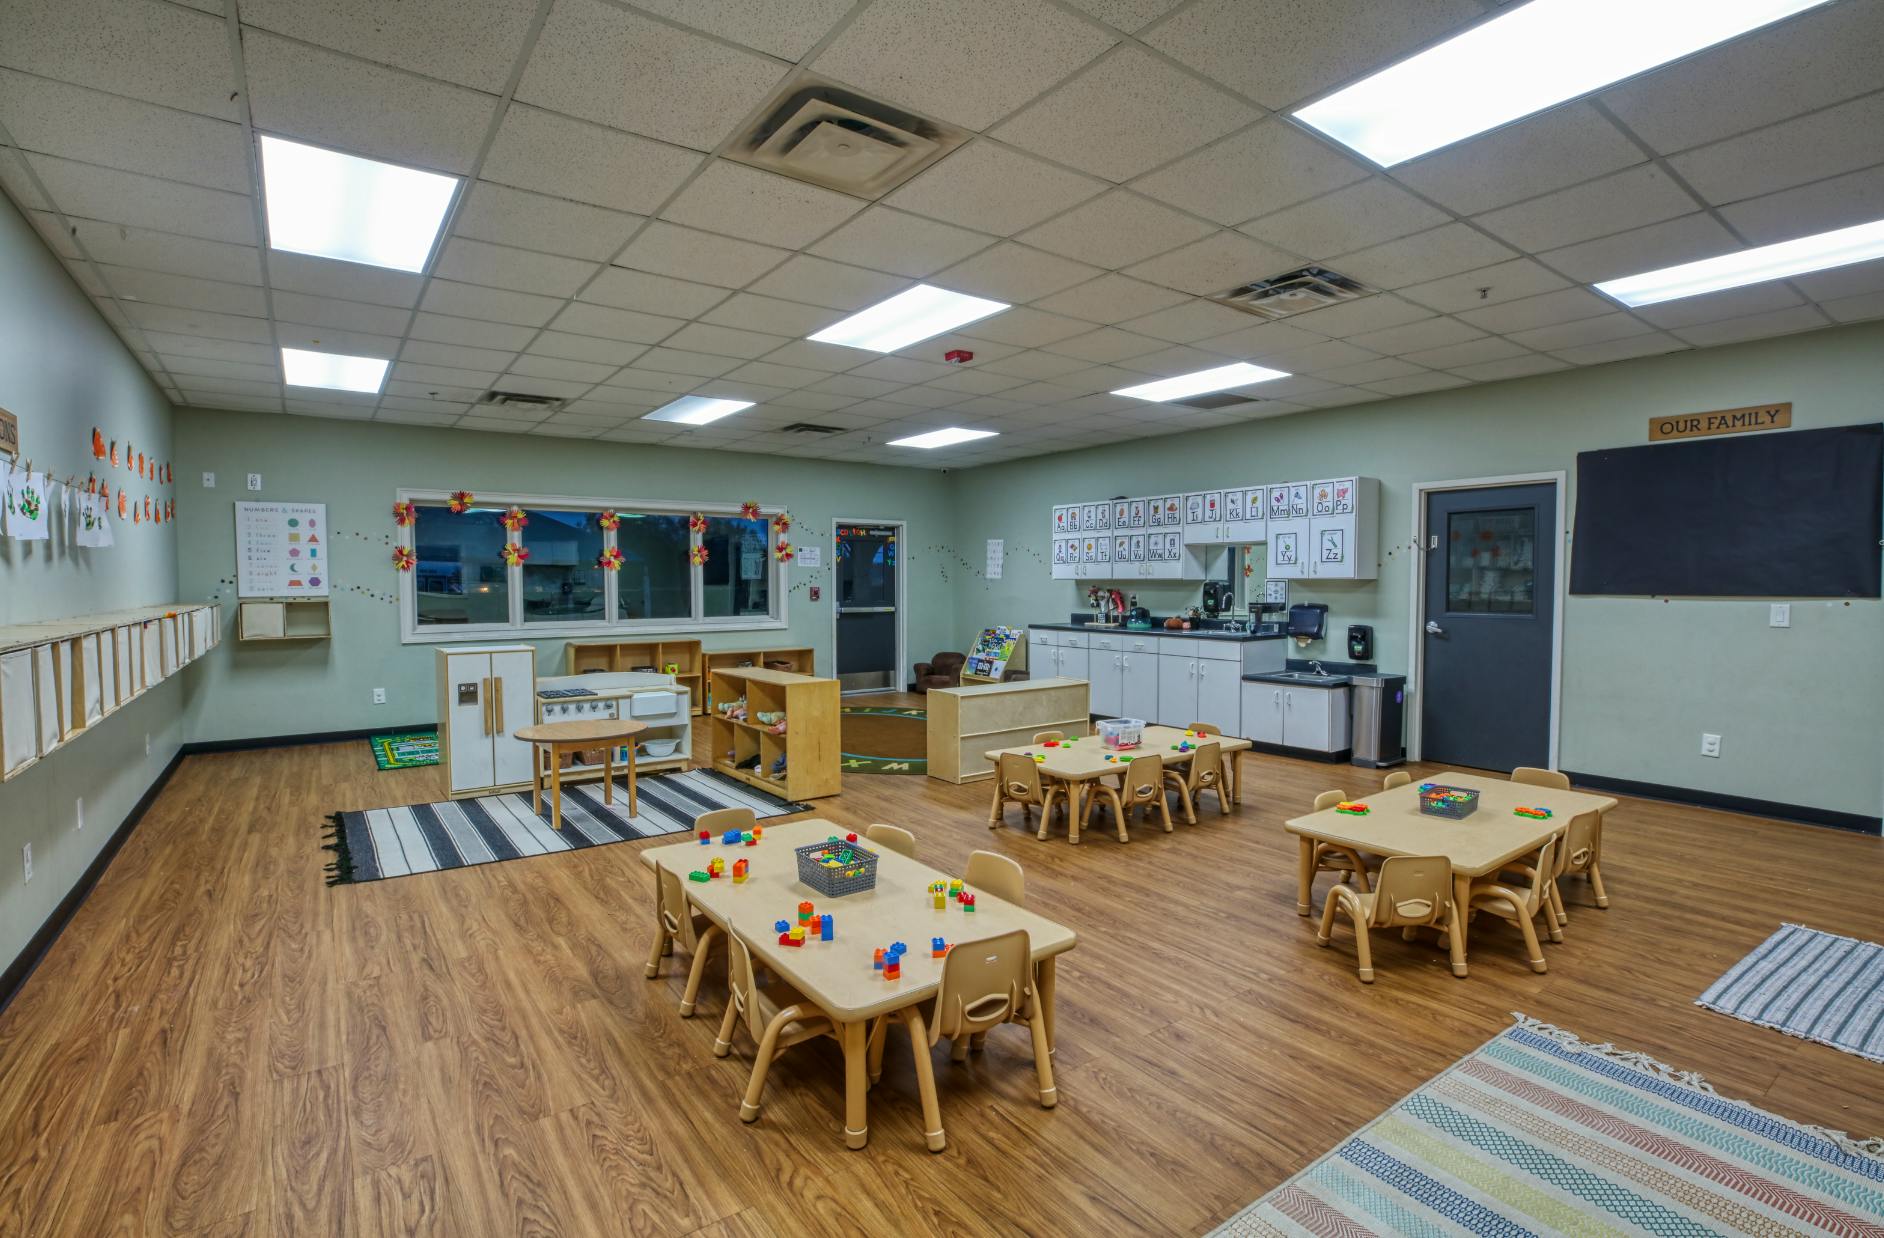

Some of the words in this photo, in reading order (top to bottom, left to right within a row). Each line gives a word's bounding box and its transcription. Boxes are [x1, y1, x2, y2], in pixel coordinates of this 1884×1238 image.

[1660, 418, 1701, 435] OUR
[1707, 409, 1780, 431] FAMILY
[243, 506, 280, 514] NUMBERS
[1271, 505, 1288, 516] Mm
[1291, 503, 1304, 515] Nn
[1316, 502, 1330, 513] Oo
[1335, 499, 1349, 513] Pp
[1167, 512, 1178, 523] Hh
[1229, 508, 1241, 519] Kk
[1069, 521, 1078, 530] Bb
[1085, 519, 1094, 529] Cc
[1099, 518, 1108, 528] Dd
[1132, 515, 1142, 526] Ff
[1151, 514, 1161, 526] Gg
[1069, 552, 1078, 561] Rr
[1100, 551, 1108, 561] Tt
[1117, 550, 1127, 560] Uu
[1167, 548, 1177, 559] Xx
[1281, 550, 1293, 563] Yy
[1325, 548, 1339, 560] Zz
